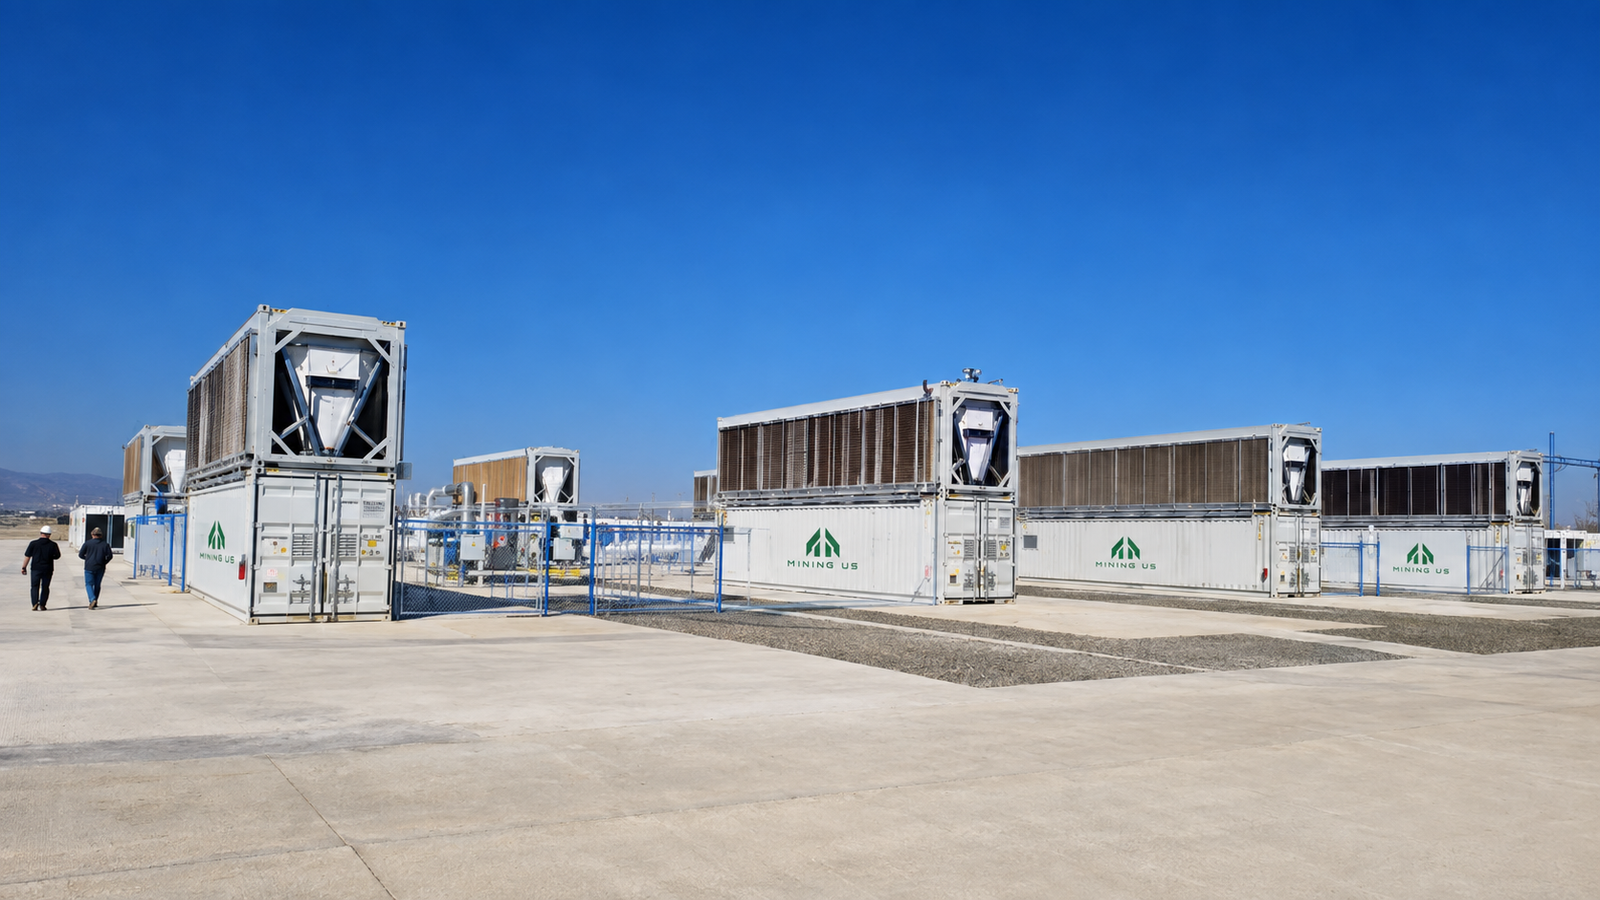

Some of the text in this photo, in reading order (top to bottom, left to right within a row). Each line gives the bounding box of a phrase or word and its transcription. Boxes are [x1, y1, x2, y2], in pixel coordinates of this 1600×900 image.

[199, 552, 235, 564] MINING US
[787, 559, 858, 570] MINING US
[1095, 561, 1136, 569] MINING
